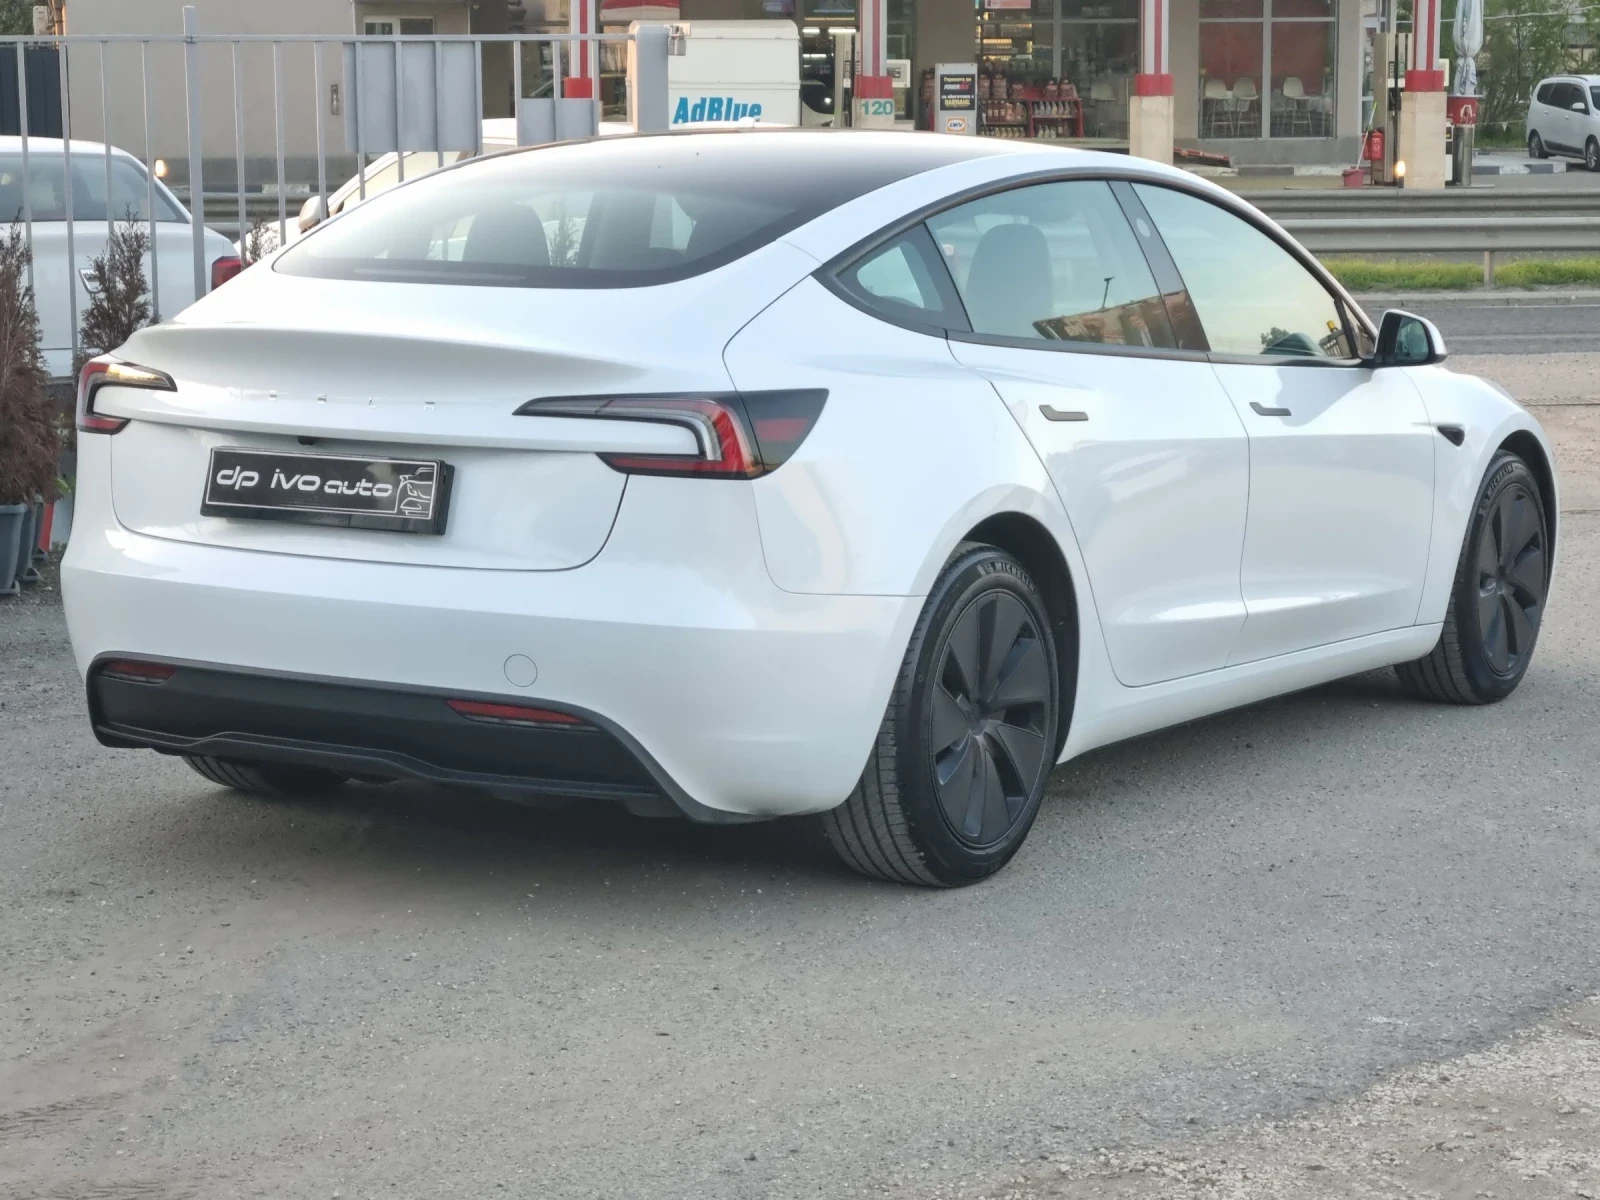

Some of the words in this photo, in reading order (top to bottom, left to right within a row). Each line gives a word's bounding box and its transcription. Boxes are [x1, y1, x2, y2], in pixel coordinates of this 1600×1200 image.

[672, 97, 762, 123] AdBlue
[860, 100, 894, 115] 120
[216, 466, 260, 490] dp
[270, 469, 321, 491] ivo
[324, 478, 393, 497] auto
